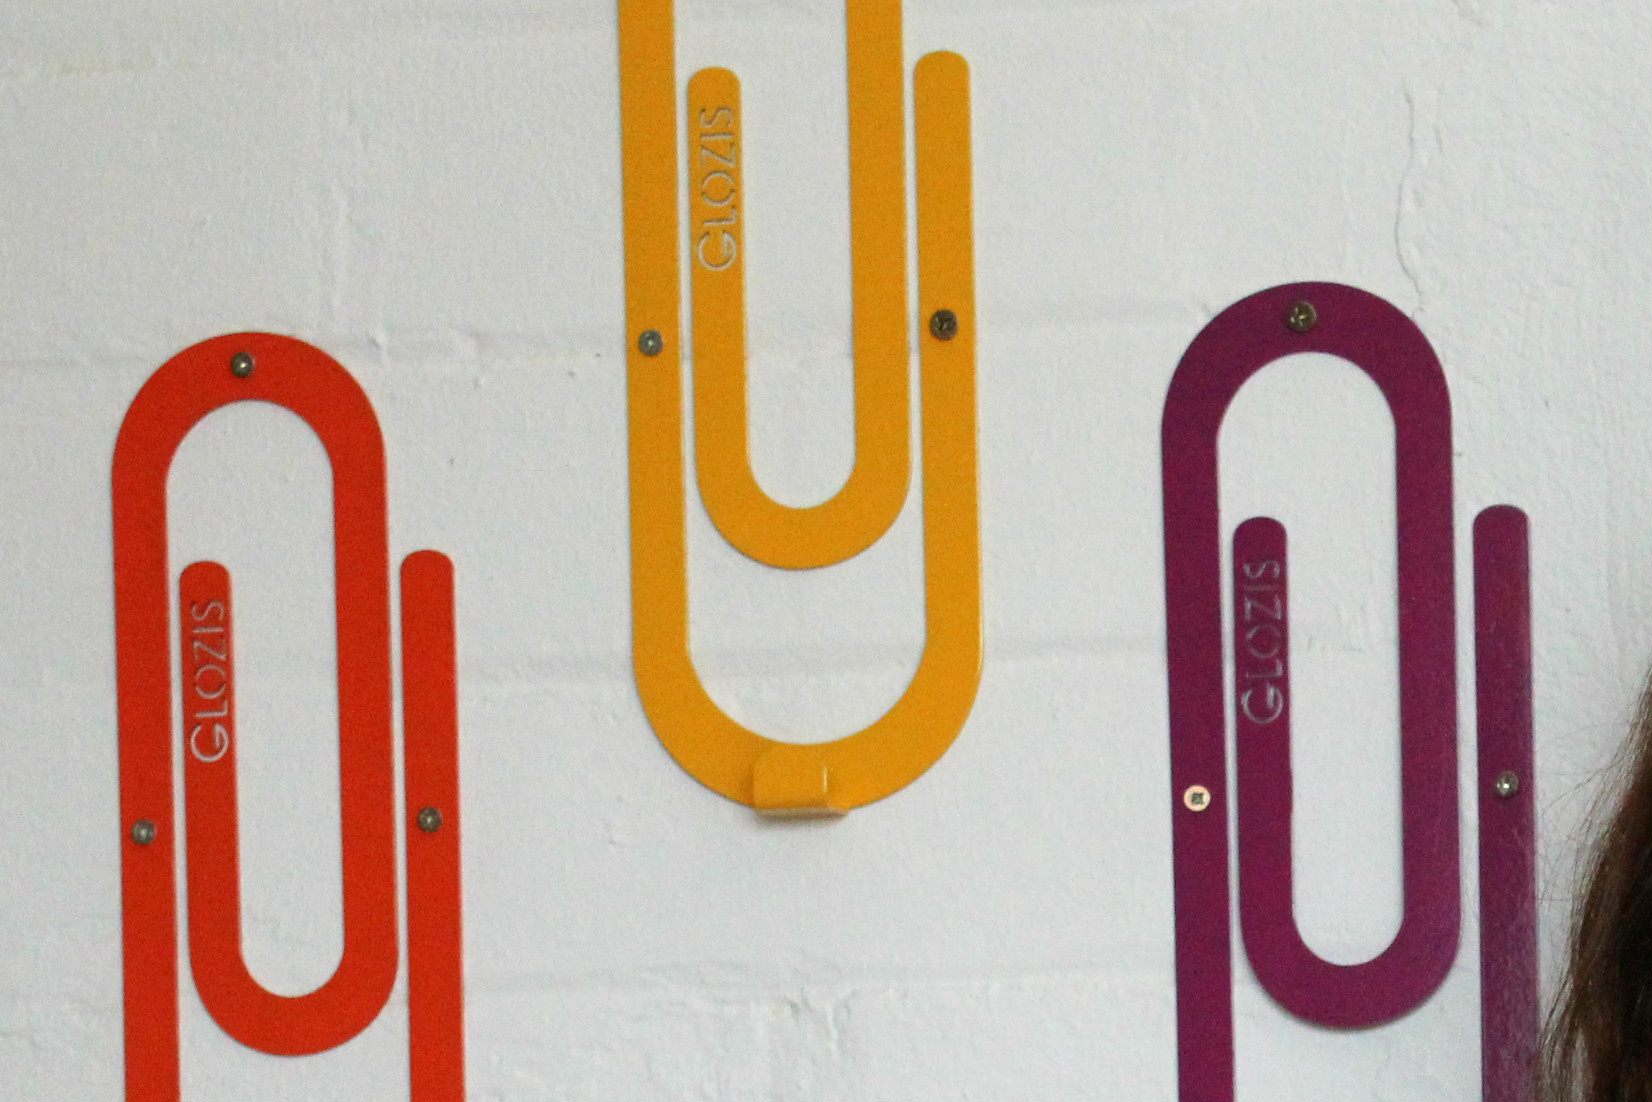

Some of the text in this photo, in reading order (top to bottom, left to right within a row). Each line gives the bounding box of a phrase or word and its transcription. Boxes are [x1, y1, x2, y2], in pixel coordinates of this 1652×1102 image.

[698, 106, 738, 270] GLOZIS
[190, 600, 230, 763] GLOZIS
[1241, 560, 1284, 725] GLOZIS
